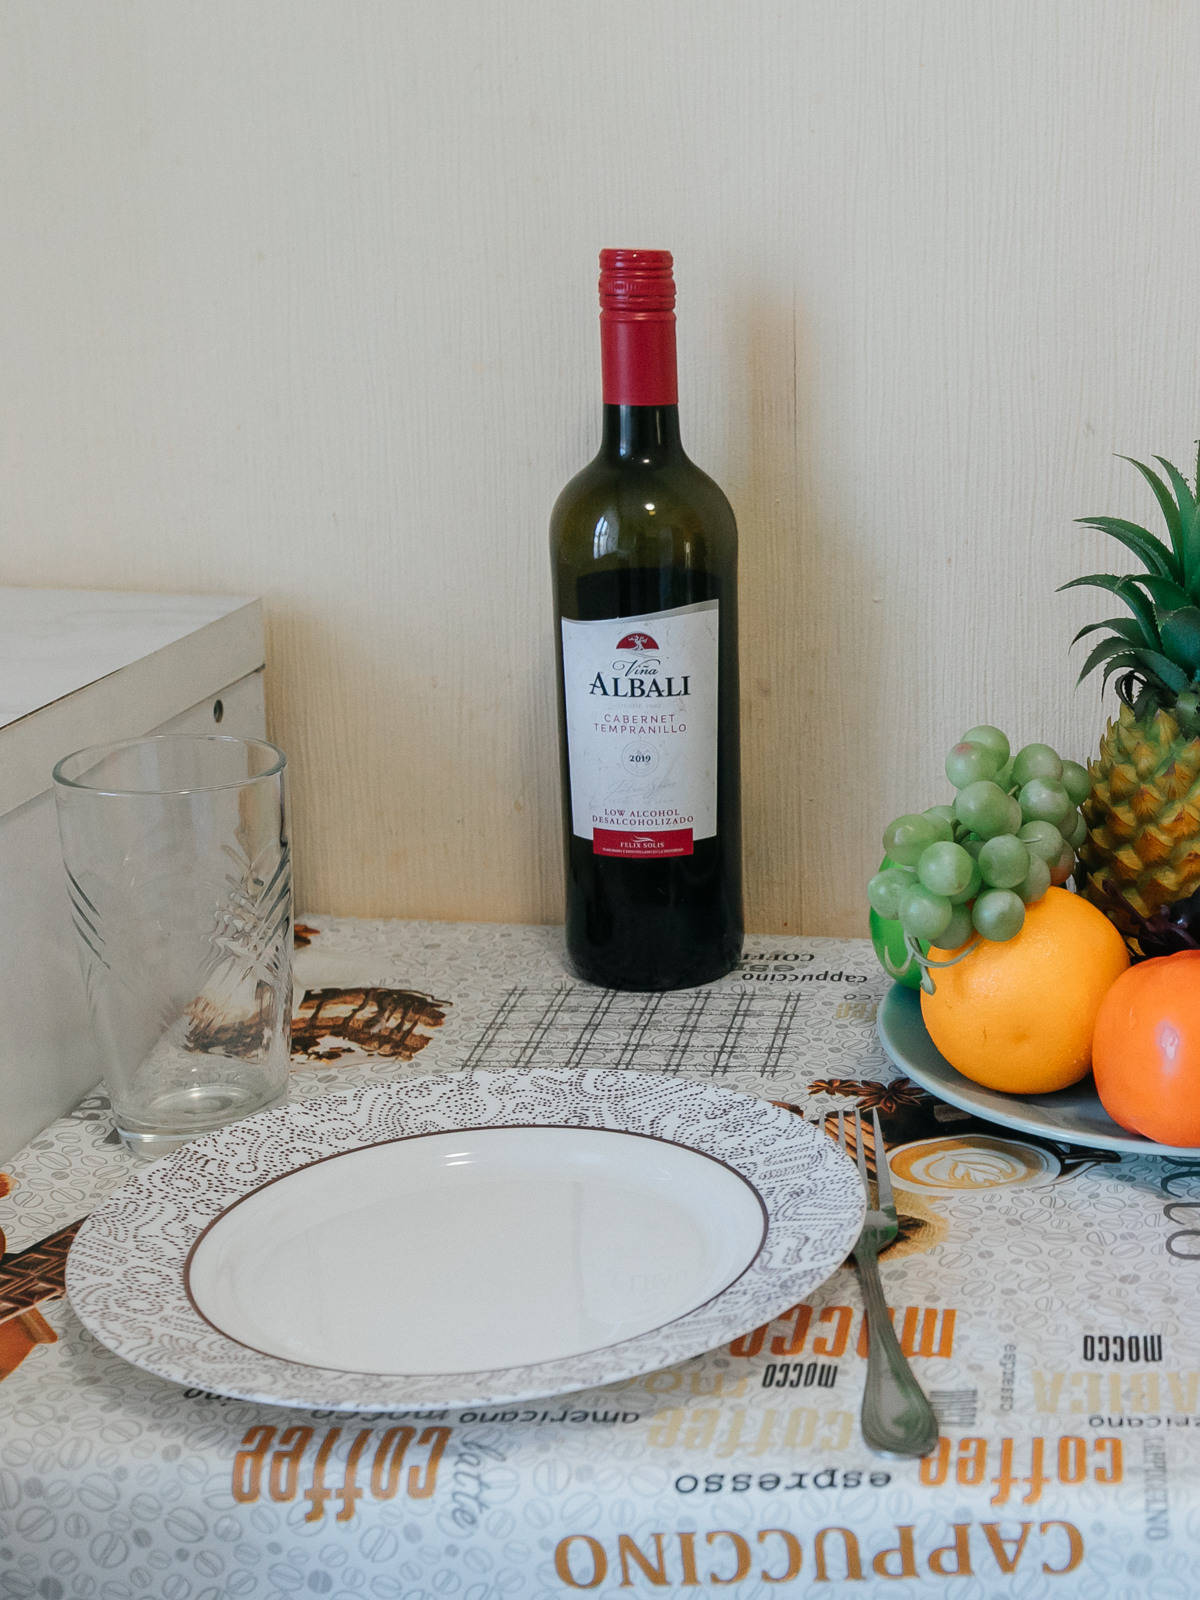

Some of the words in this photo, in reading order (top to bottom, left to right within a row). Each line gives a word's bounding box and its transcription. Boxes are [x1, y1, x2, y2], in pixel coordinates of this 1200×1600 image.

[612, 658, 662, 678] Viña
[589, 671, 691, 698] ALBALI
[604, 713, 675, 725] CABERNET
[594, 722, 687, 735] TEMPRANILLO
[629, 754, 651, 763] 2019
[592, 814, 694, 827] DESALCOHOLIZADO
[604, 808, 626, 817] LOW
[630, 808, 680, 818] ALCOHOL
[620, 841, 641, 849] FELIX
[643, 841, 665, 849] SOLIS
[741, 970, 868, 985] cappuccino
[459, 1410, 640, 1427] americano
[646, 1406, 854, 1459] coffee
[232, 1425, 453, 1523] coffee
[918, 1435, 1124, 1507] coffee
[675, 1468, 892, 1495] espresso
[554, 1520, 1085, 1589] CAPPUCCINO
